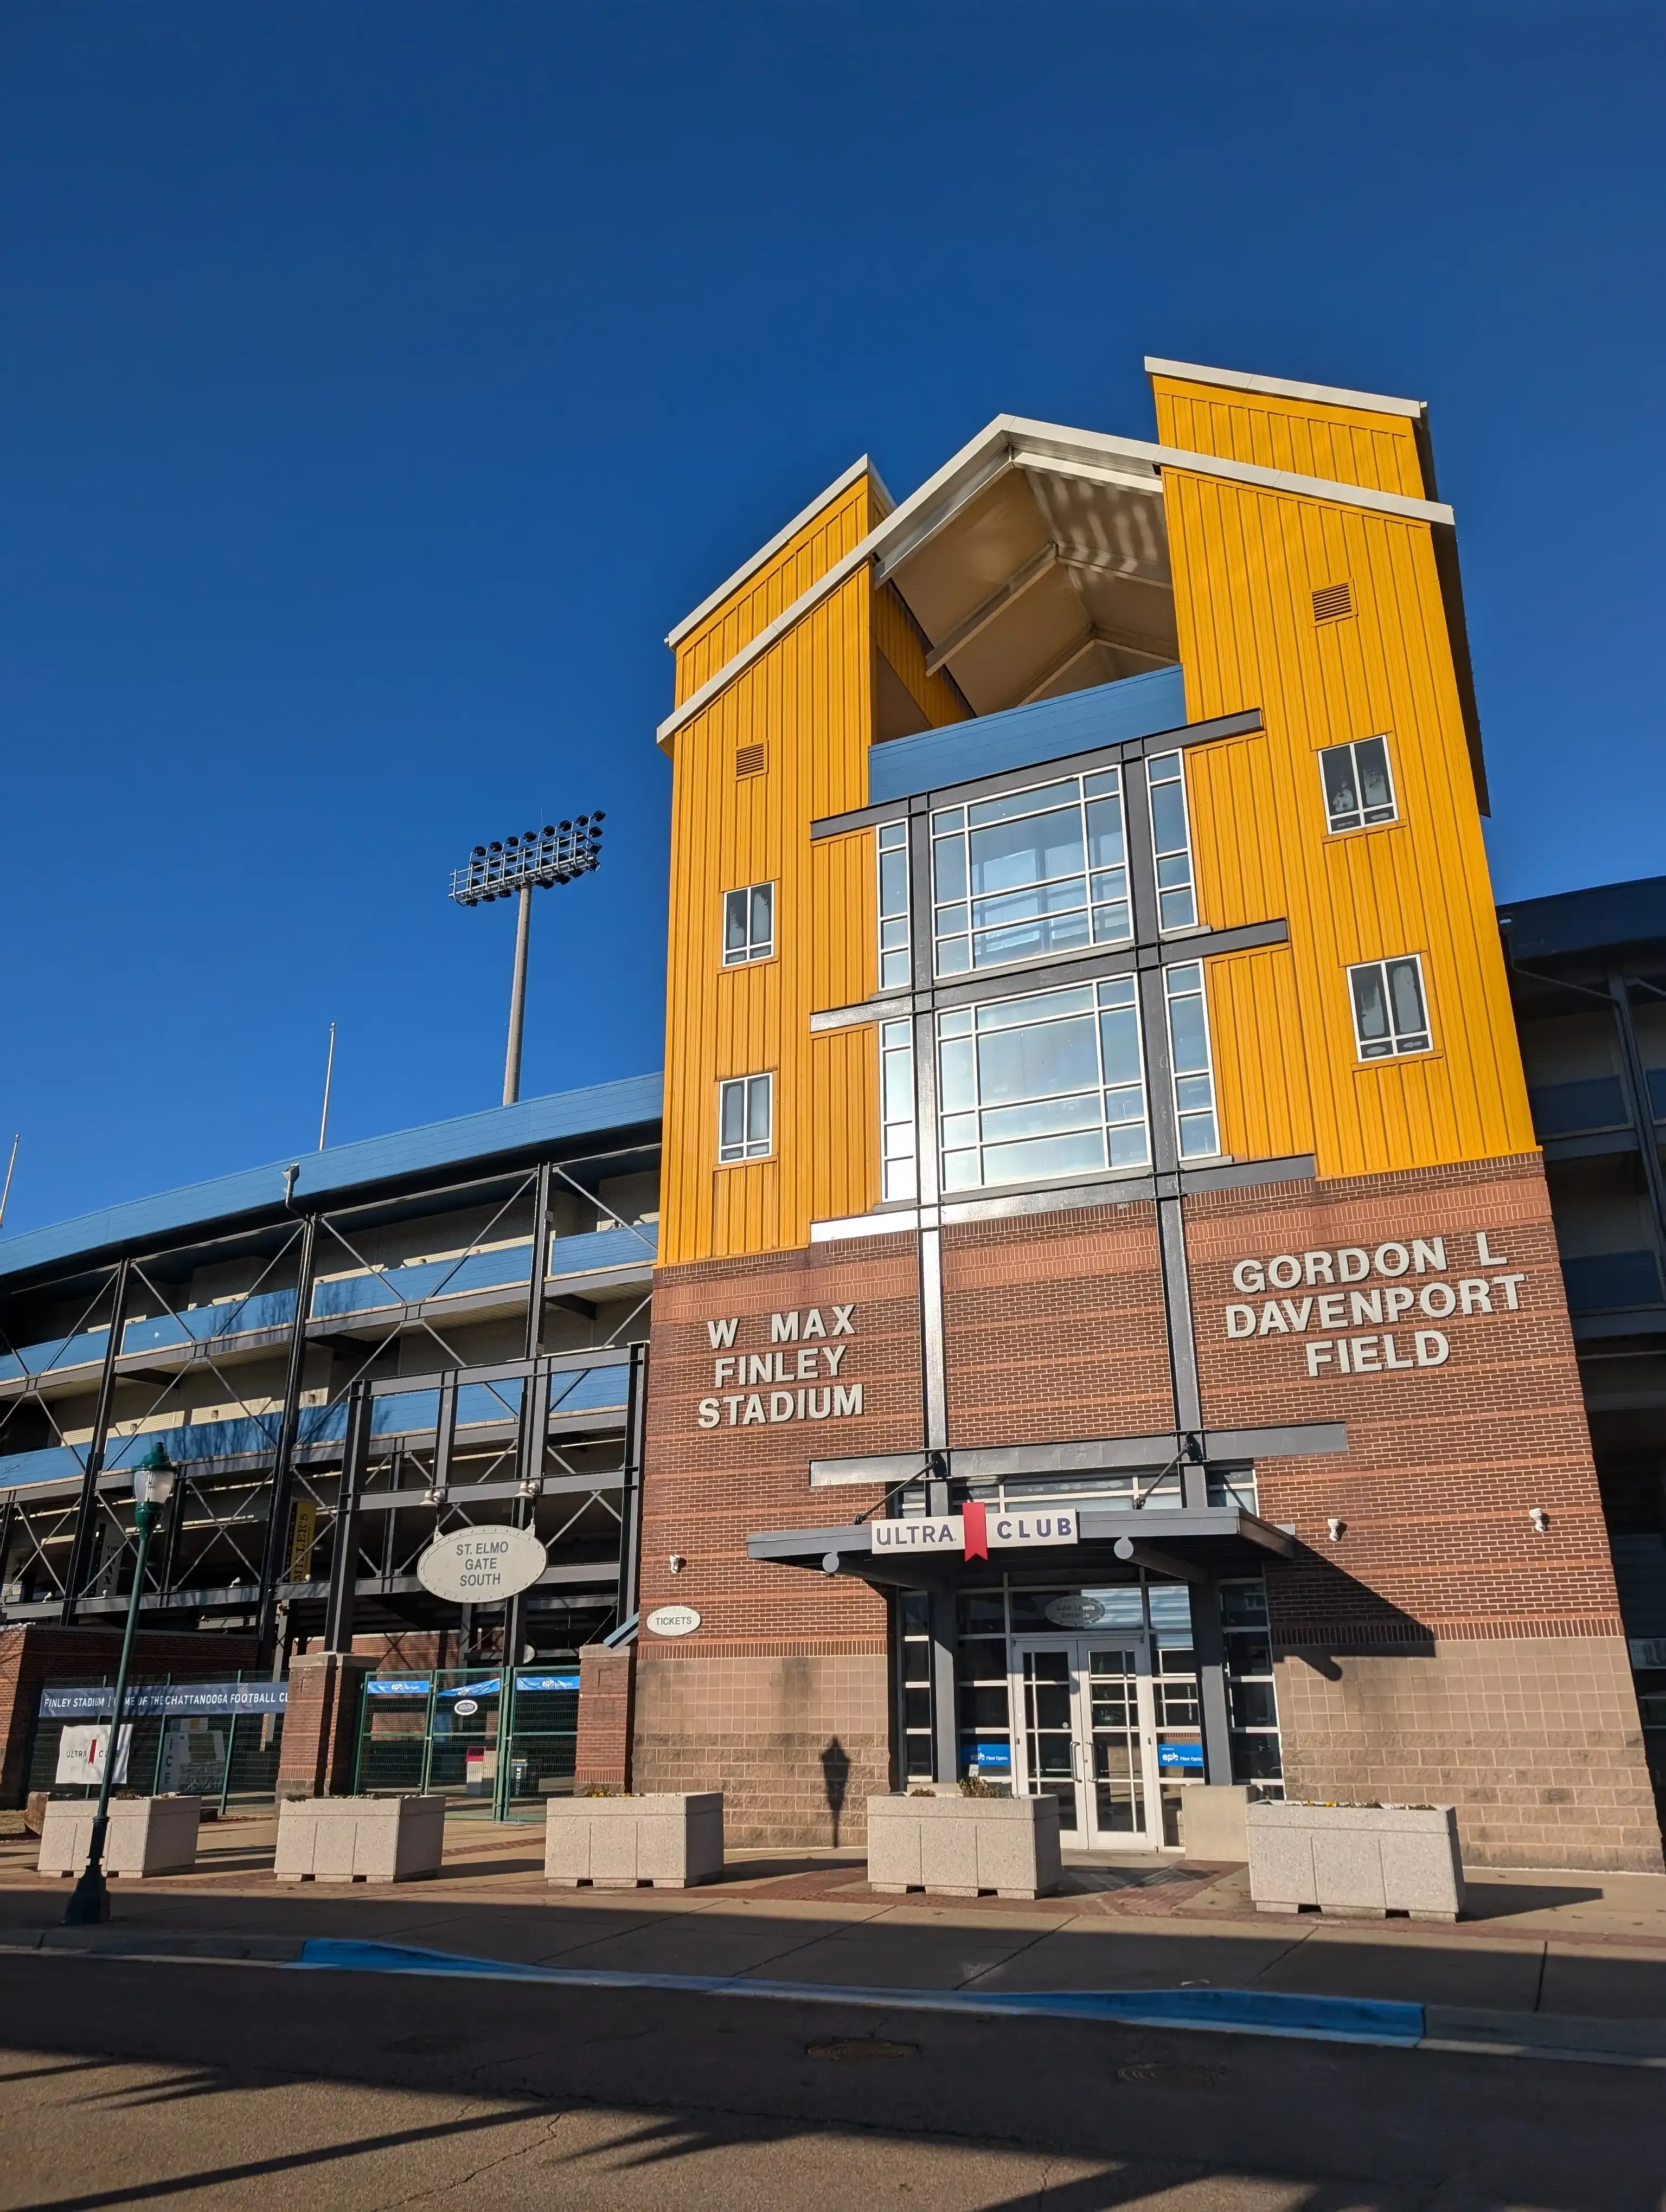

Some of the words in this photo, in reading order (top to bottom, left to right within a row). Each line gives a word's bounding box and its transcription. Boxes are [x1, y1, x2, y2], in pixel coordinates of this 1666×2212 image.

[1233, 1236, 1447, 1294] GORDON
[1476, 1232, 1508, 1267] L
[1225, 1274, 1526, 1339] DAVENPORT
[707, 1317, 740, 1349] W
[771, 1304, 857, 1343] MAX
[1305, 1330, 1451, 1378] FIELD
[715, 1345, 848, 1388] FINLEY
[698, 1384, 864, 1429] STADIUM
[876, 1524, 955, 1546] ULTRA
[996, 1517, 1072, 1539] CLUB
[456, 1544, 472, 1556] ST.
[475, 1541, 509, 1554] ELMO
[465, 1557, 497, 1571] GATE
[459, 1573, 501, 1587] SOUTH
[655, 1616, 693, 1625] TICKETS
[44, 1697, 72, 1708] FINLEY
[73, 1696, 105, 1707] STADIUM
[137, 1696, 148, 1706] OF
[150, 1695, 163, 1706] THE
[164, 1693, 228, 1705] CHATTANOOGA
[230, 1692, 276, 1704] FOOTBALL
[279, 1692, 289, 1702] CL
[66, 1750, 87, 1758] ULTRA
[99, 1750, 120, 1758] CLB
[1162, 1752, 1178, 1763] epb
